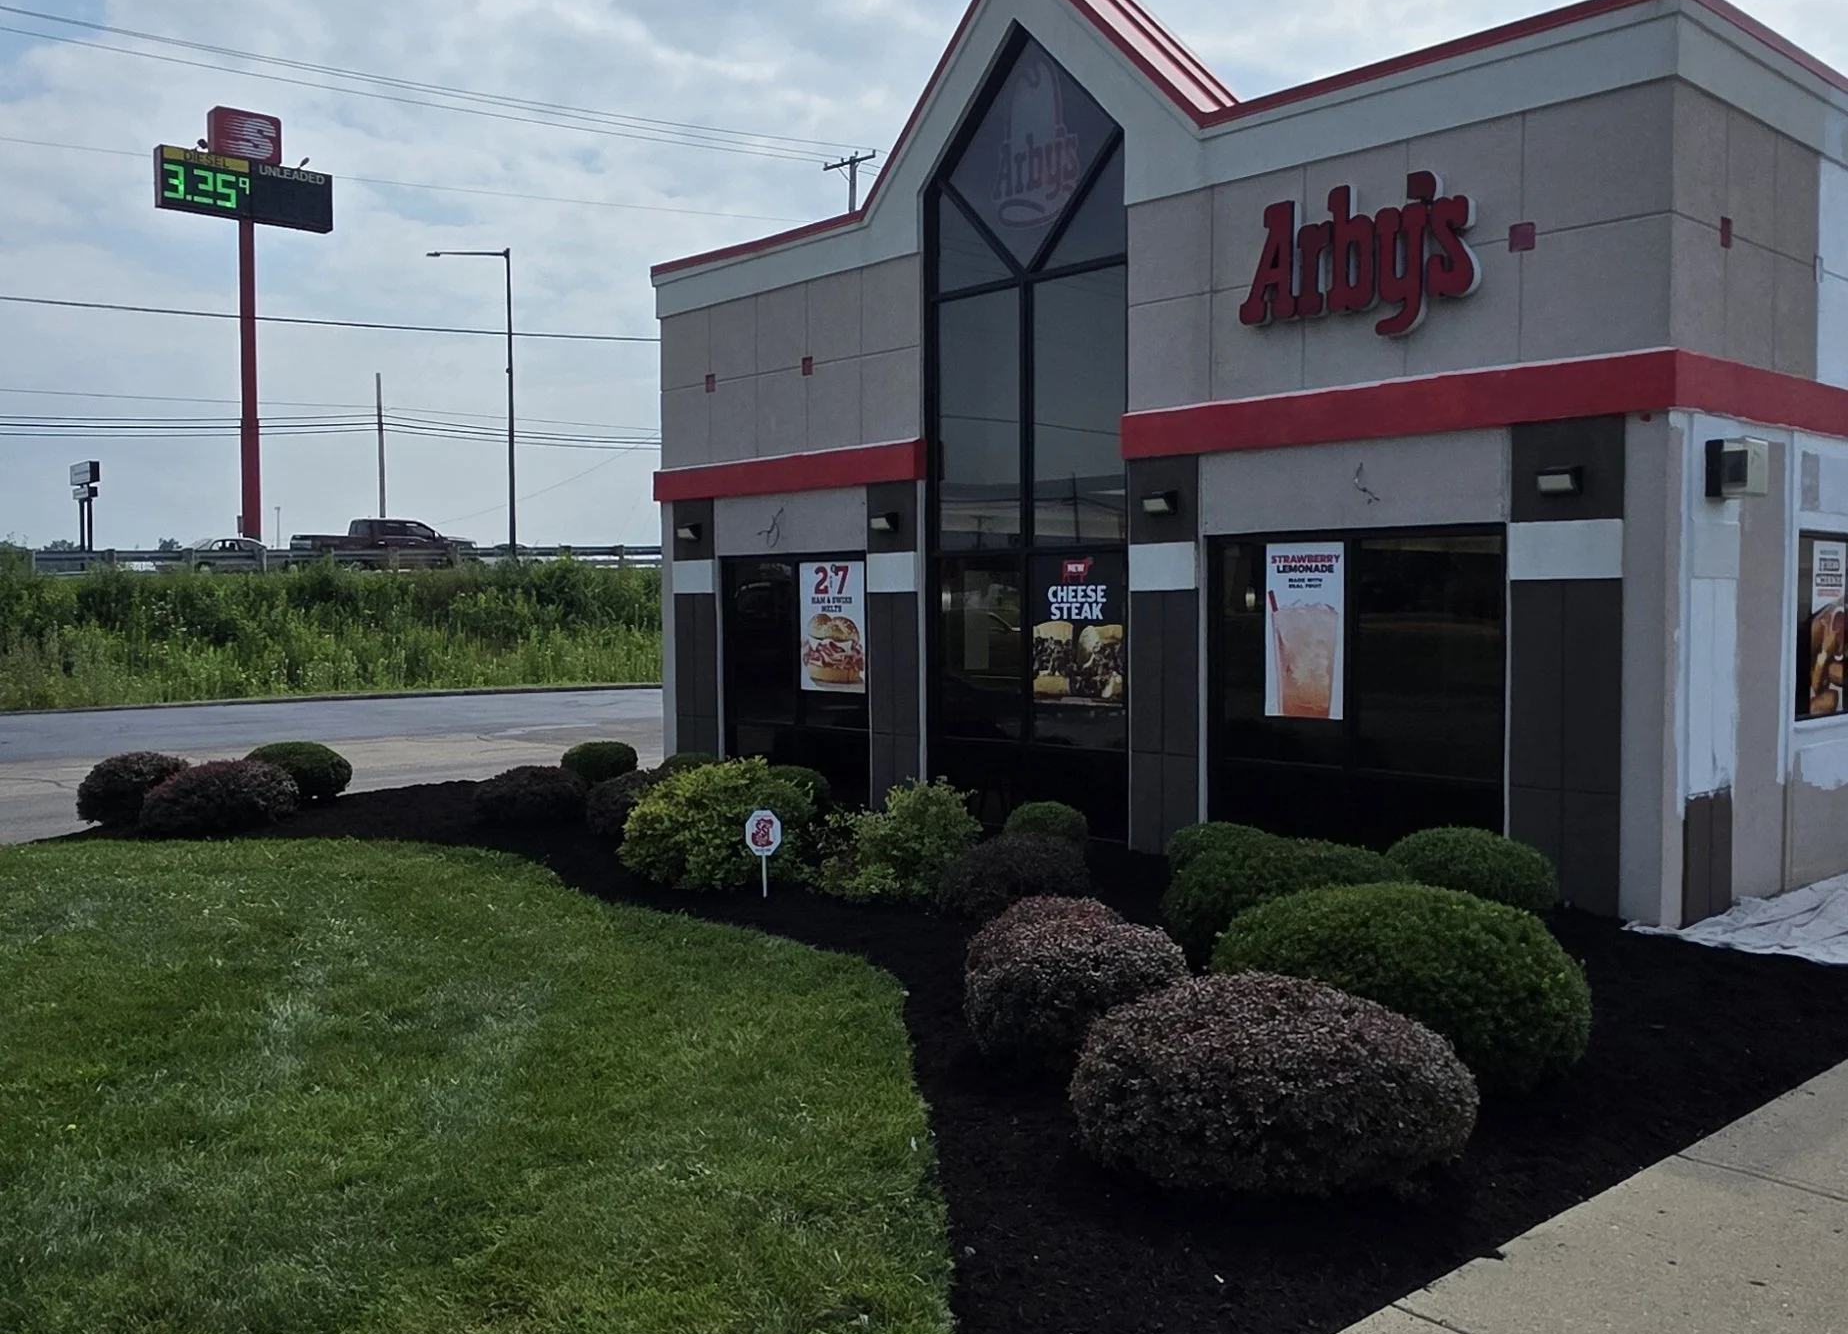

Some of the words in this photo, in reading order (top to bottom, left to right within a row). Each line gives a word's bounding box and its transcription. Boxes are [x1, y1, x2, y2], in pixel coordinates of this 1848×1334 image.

[183, 149, 231, 168] DIESEL
[992, 126, 1079, 202] Arby's
[259, 164, 326, 185] UNLEADED
[1239, 170, 1482, 337] Arby's
[1067, 564, 1085, 572] NEW
[1271, 554, 1340, 564] STRAWBERRY
[1277, 564, 1334, 573] LEMONADE
[814, 566, 829, 595] 2
[1047, 585, 1107, 603] CHEESE
[821, 605, 842, 613] MELTS
[1050, 603, 1104, 620] STEAK
